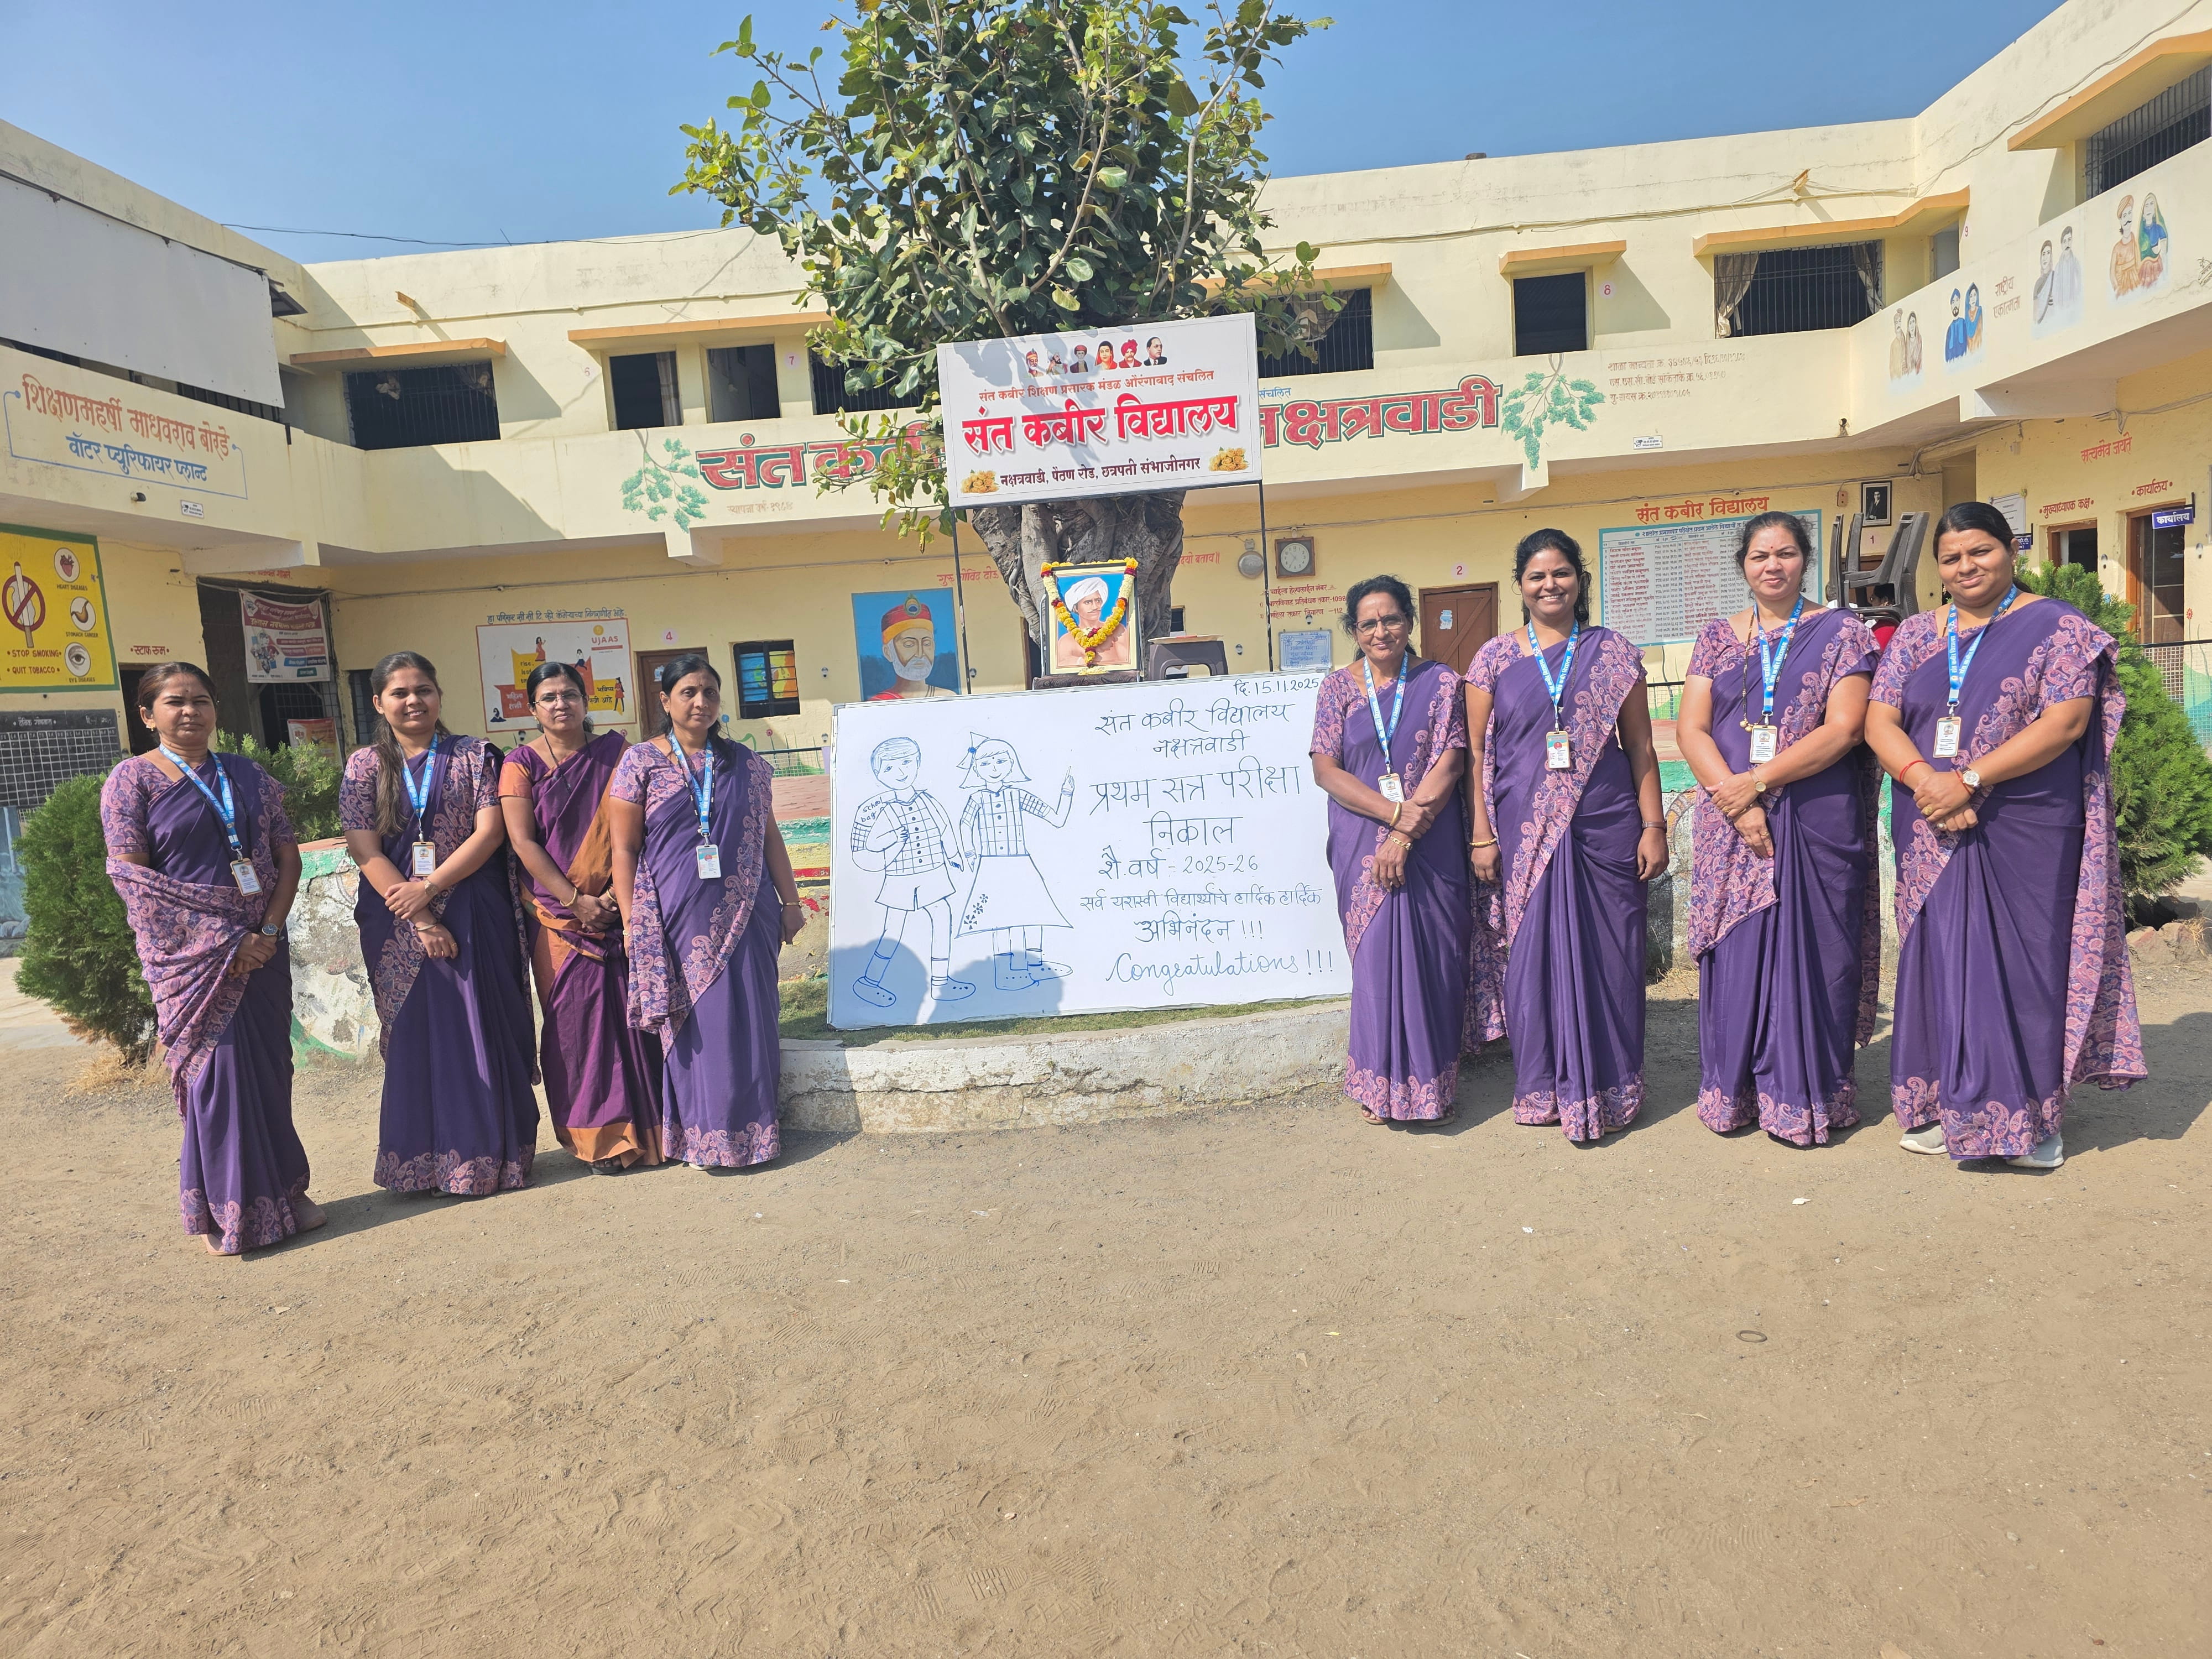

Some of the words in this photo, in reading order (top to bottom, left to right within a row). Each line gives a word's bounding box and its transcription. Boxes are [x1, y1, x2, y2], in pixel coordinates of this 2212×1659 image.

[1965, 226, 1969, 237] 9
[1604, 284, 1611, 295] 8
[789, 356, 795, 365] 7
[979, 389, 995, 401] संत
[998, 387, 1024, 399] कबीर
[1027, 385, 1057, 398] शिक्षण
[1061, 382, 1095, 394] प्रसारक
[1098, 378, 1121, 390] मंडळ
[1124, 374, 1174, 387] औरंगाबाद
[1176, 369, 1214, 383] संचलित
[23, 373, 122, 433] शिक्षणमहर्षी
[127, 409, 195, 452] माधवराव
[962, 405, 1014, 454] संत
[1021, 398, 1107, 447] कबीर
[1114, 393, 1238, 440] विद्यालय
[65, 432, 103, 463] वॉटर
[174, 460, 207, 482] प्लान्ट
[2080, 439, 2111, 464] सत्यमेव
[2112, 431, 2132, 455] जयते
[696, 433, 807, 490] संत
[1000, 468, 1048, 487] नक्षत्रवाडी,
[1052, 467, 1074, 481] पैठण
[1078, 464, 1098, 479] रोड,
[1102, 458, 1137, 477] छत्रपती
[1140, 455, 1200, 474] संभाजीनगर
[2136, 478, 2168, 497] कार्यालय
[1636, 503, 1660, 524] संत
[1664, 503, 1704, 520] कबीर
[1709, 497, 1769, 516] विद्यालय
[2078, 498, 2090, 509] कक्ष
[2157, 512, 2190, 525] कार्यालय
[1870, 535, 1875, 544] 1
[1456, 565, 1463, 575] 2
[591, 636, 619, 645] UJAAS
[666, 632, 673, 640] 4
[133, 645, 151, 655] स्टाफ
[1761, 644, 1769, 664] विद्यालय
[1775, 641, 1788, 662] विद्यालय
[1537, 658, 1549, 676] विद्यालय
[1561, 655, 1572, 673] विद्यालय
[1771, 661, 1781, 675] कबीर
[1768, 674, 1776, 684] संत
[1094, 709, 1136, 735] संत
[1141, 698, 1209, 732] कबीर
[1205, 697, 1296, 727] विद्यालय
[1370, 701, 1381, 719] विद्यालय
[1153, 729, 1251, 759] नक्षत्रवाडी
[1089, 778, 1157, 816] प्रथम
[1216, 755, 1300, 799] परीक्षा
[862, 797, 883, 812] school
[860, 811, 877, 822] bag
[1143, 811, 1243, 847] निकाल
[1182, 854, 1259, 874] 2025-26
[1080, 889, 1106, 911] सर्व
[1110, 890, 1162, 911] यशस्वी
[1134, 910, 1235, 942] अभिनंदन
[1106, 951, 1298, 996] Congratulations
